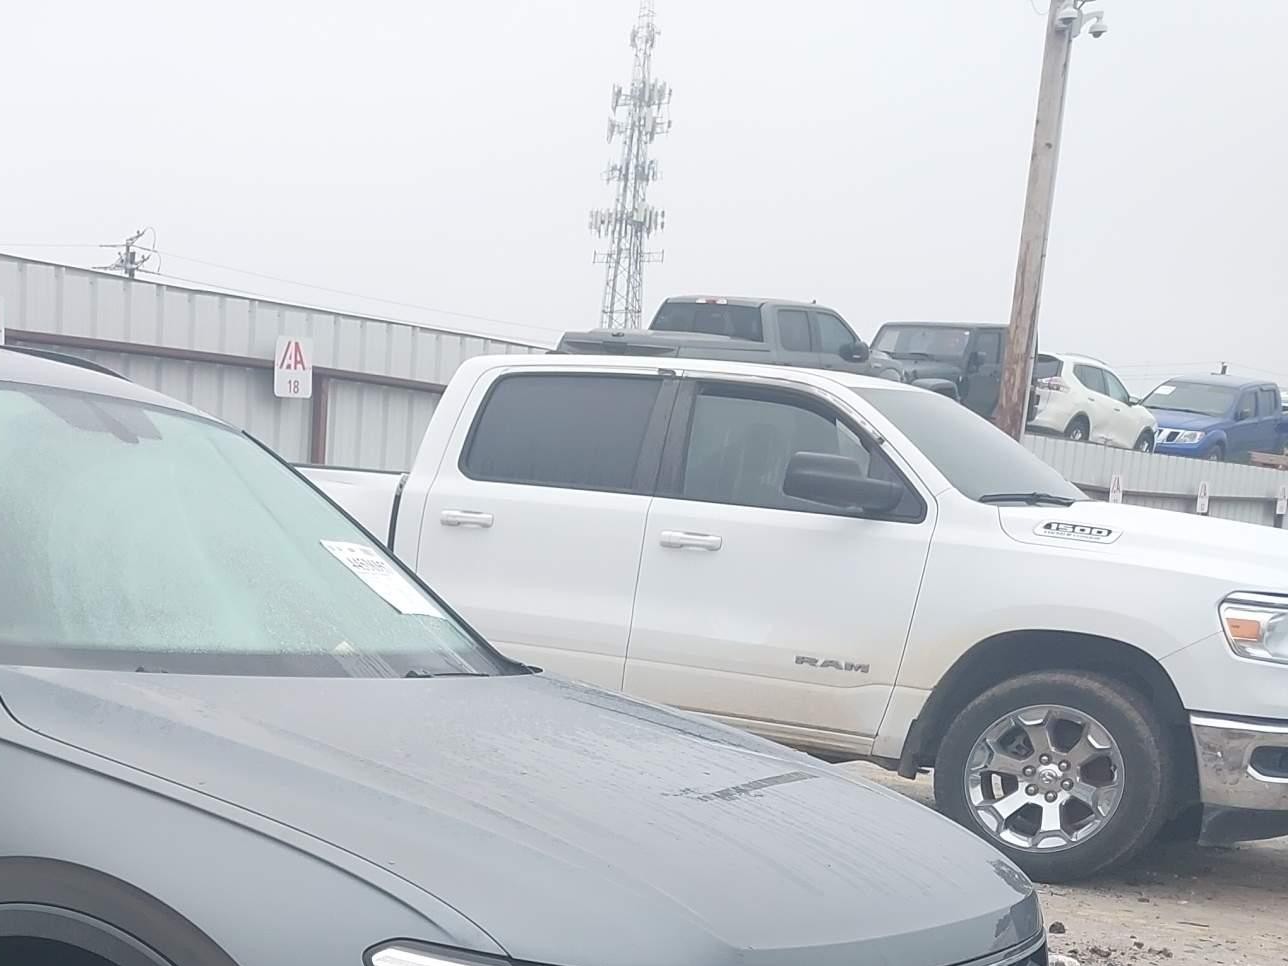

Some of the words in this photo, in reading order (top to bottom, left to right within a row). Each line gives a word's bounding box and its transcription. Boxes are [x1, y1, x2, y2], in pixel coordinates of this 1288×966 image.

[288, 380, 300, 394] 18
[1047, 522, 1111, 537] 1500
[795, 655, 870, 673] RAM
